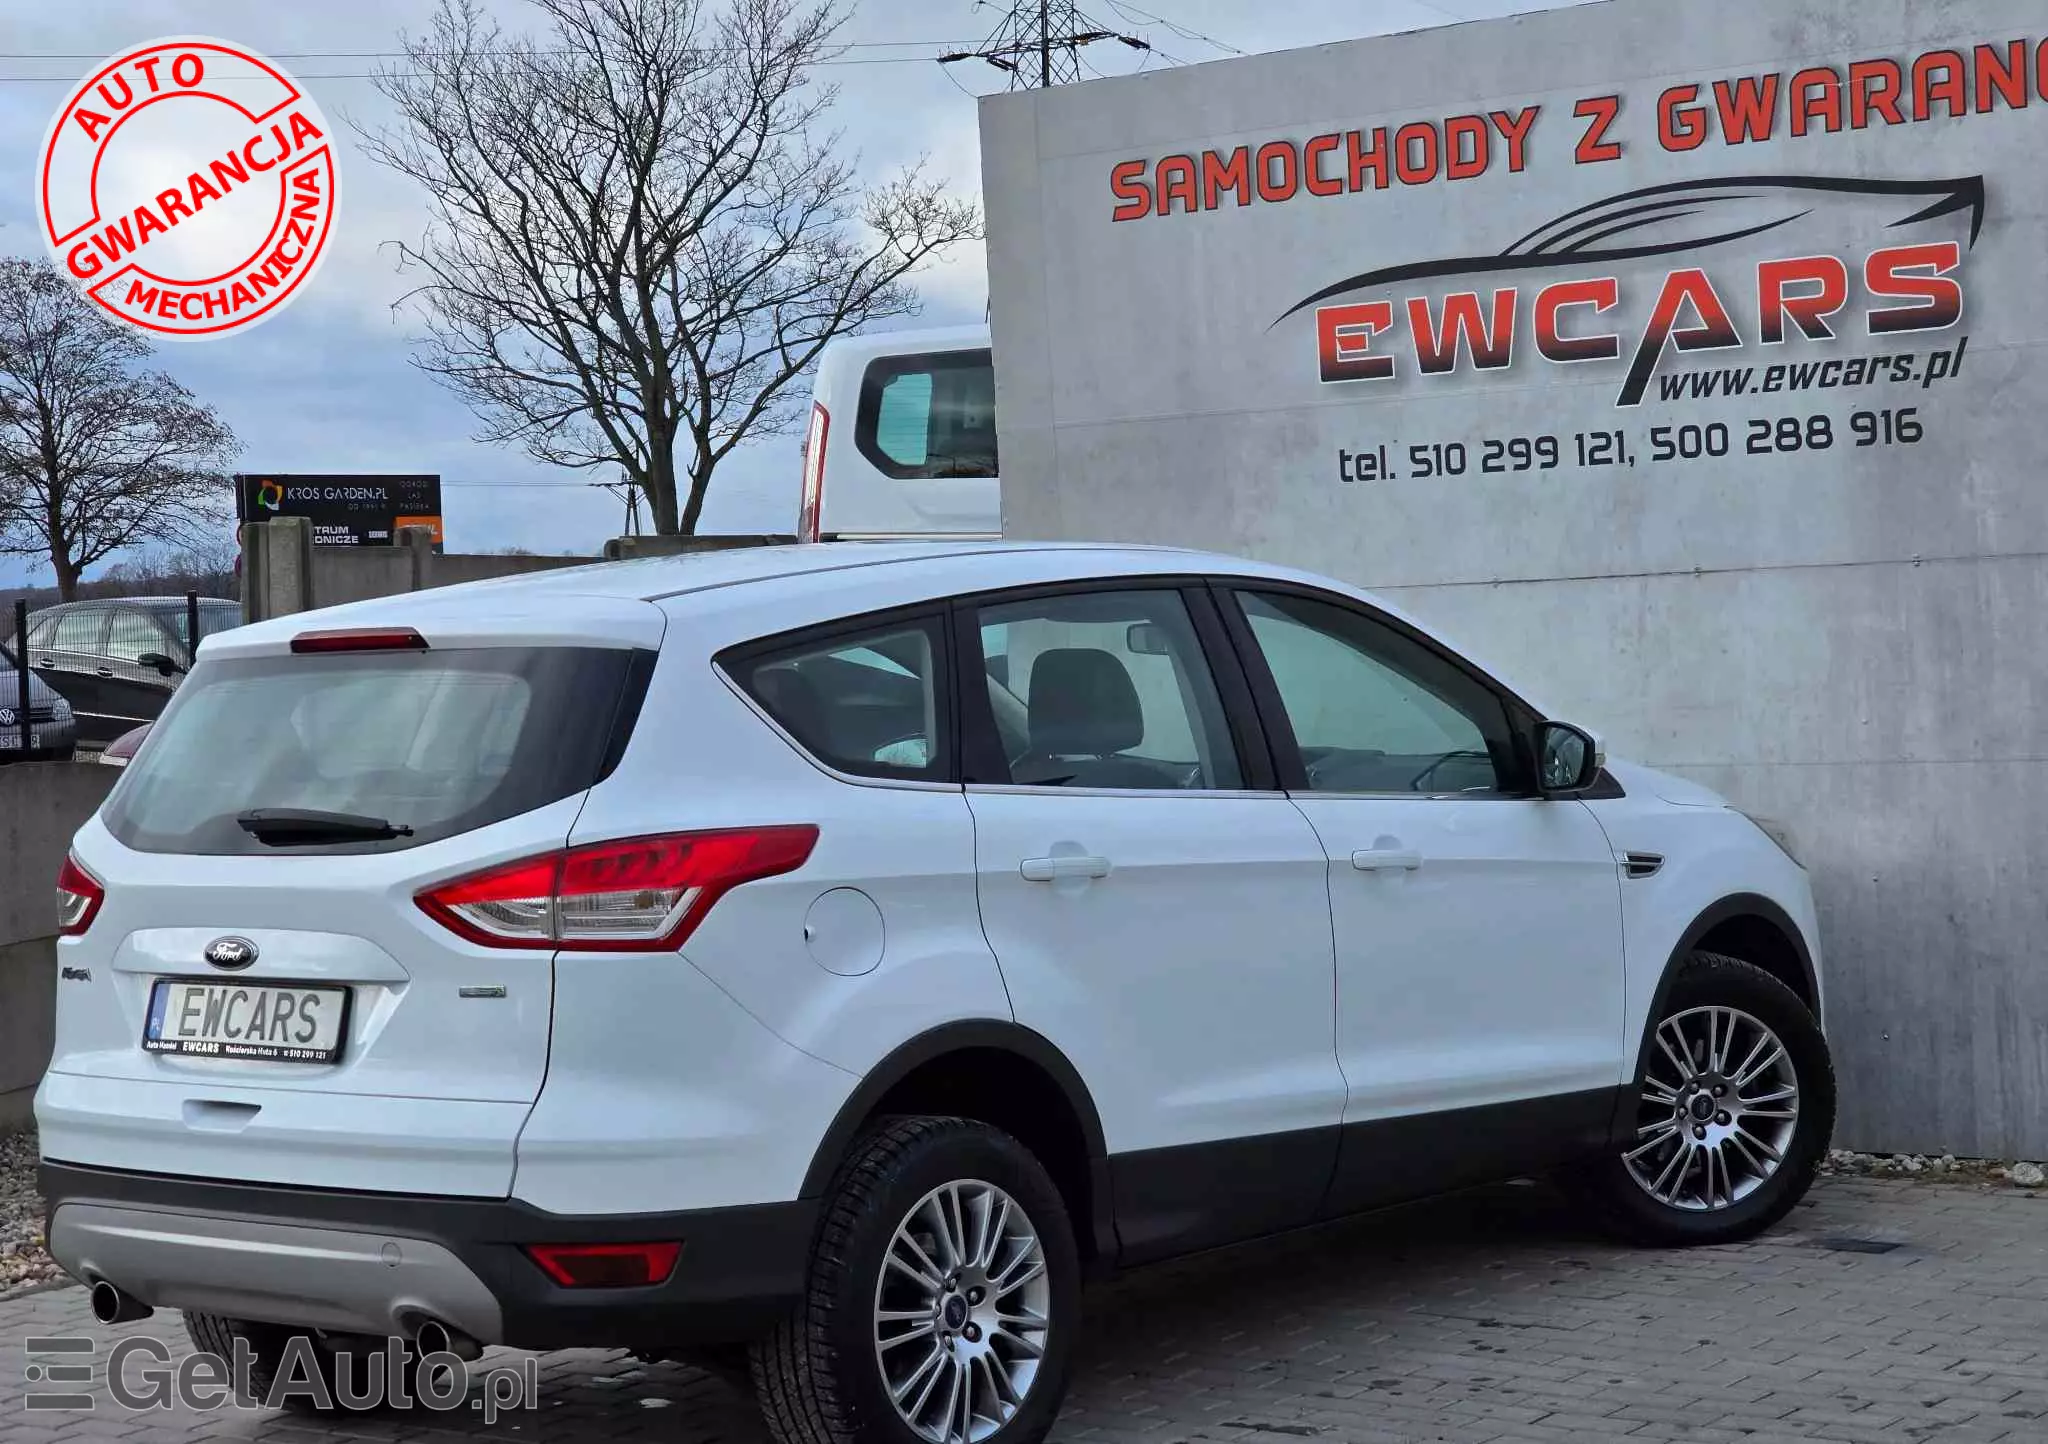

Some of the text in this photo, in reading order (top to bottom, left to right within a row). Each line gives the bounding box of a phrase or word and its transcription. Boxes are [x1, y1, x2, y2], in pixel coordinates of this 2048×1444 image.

[1111, 36, 2048, 222] SAMOCHODY Z GWARAN
[1316, 241, 1963, 408] EWCARS
[1660, 336, 1968, 400] www.ewcars.pl
[1339, 408, 1923, 482] tel. 510 299 121, 500 288 916
[287, 487, 389, 500] KROS GARDEN.PL
[313, 526, 349, 534] TRUM
[212, 942, 243, 961] Ford
[178, 988, 320, 1043] EWCARS
[182, 1041, 220, 1053] EWCARS
[289, 1049, 301, 1058] 510
[301, 1050, 314, 1059] 299
